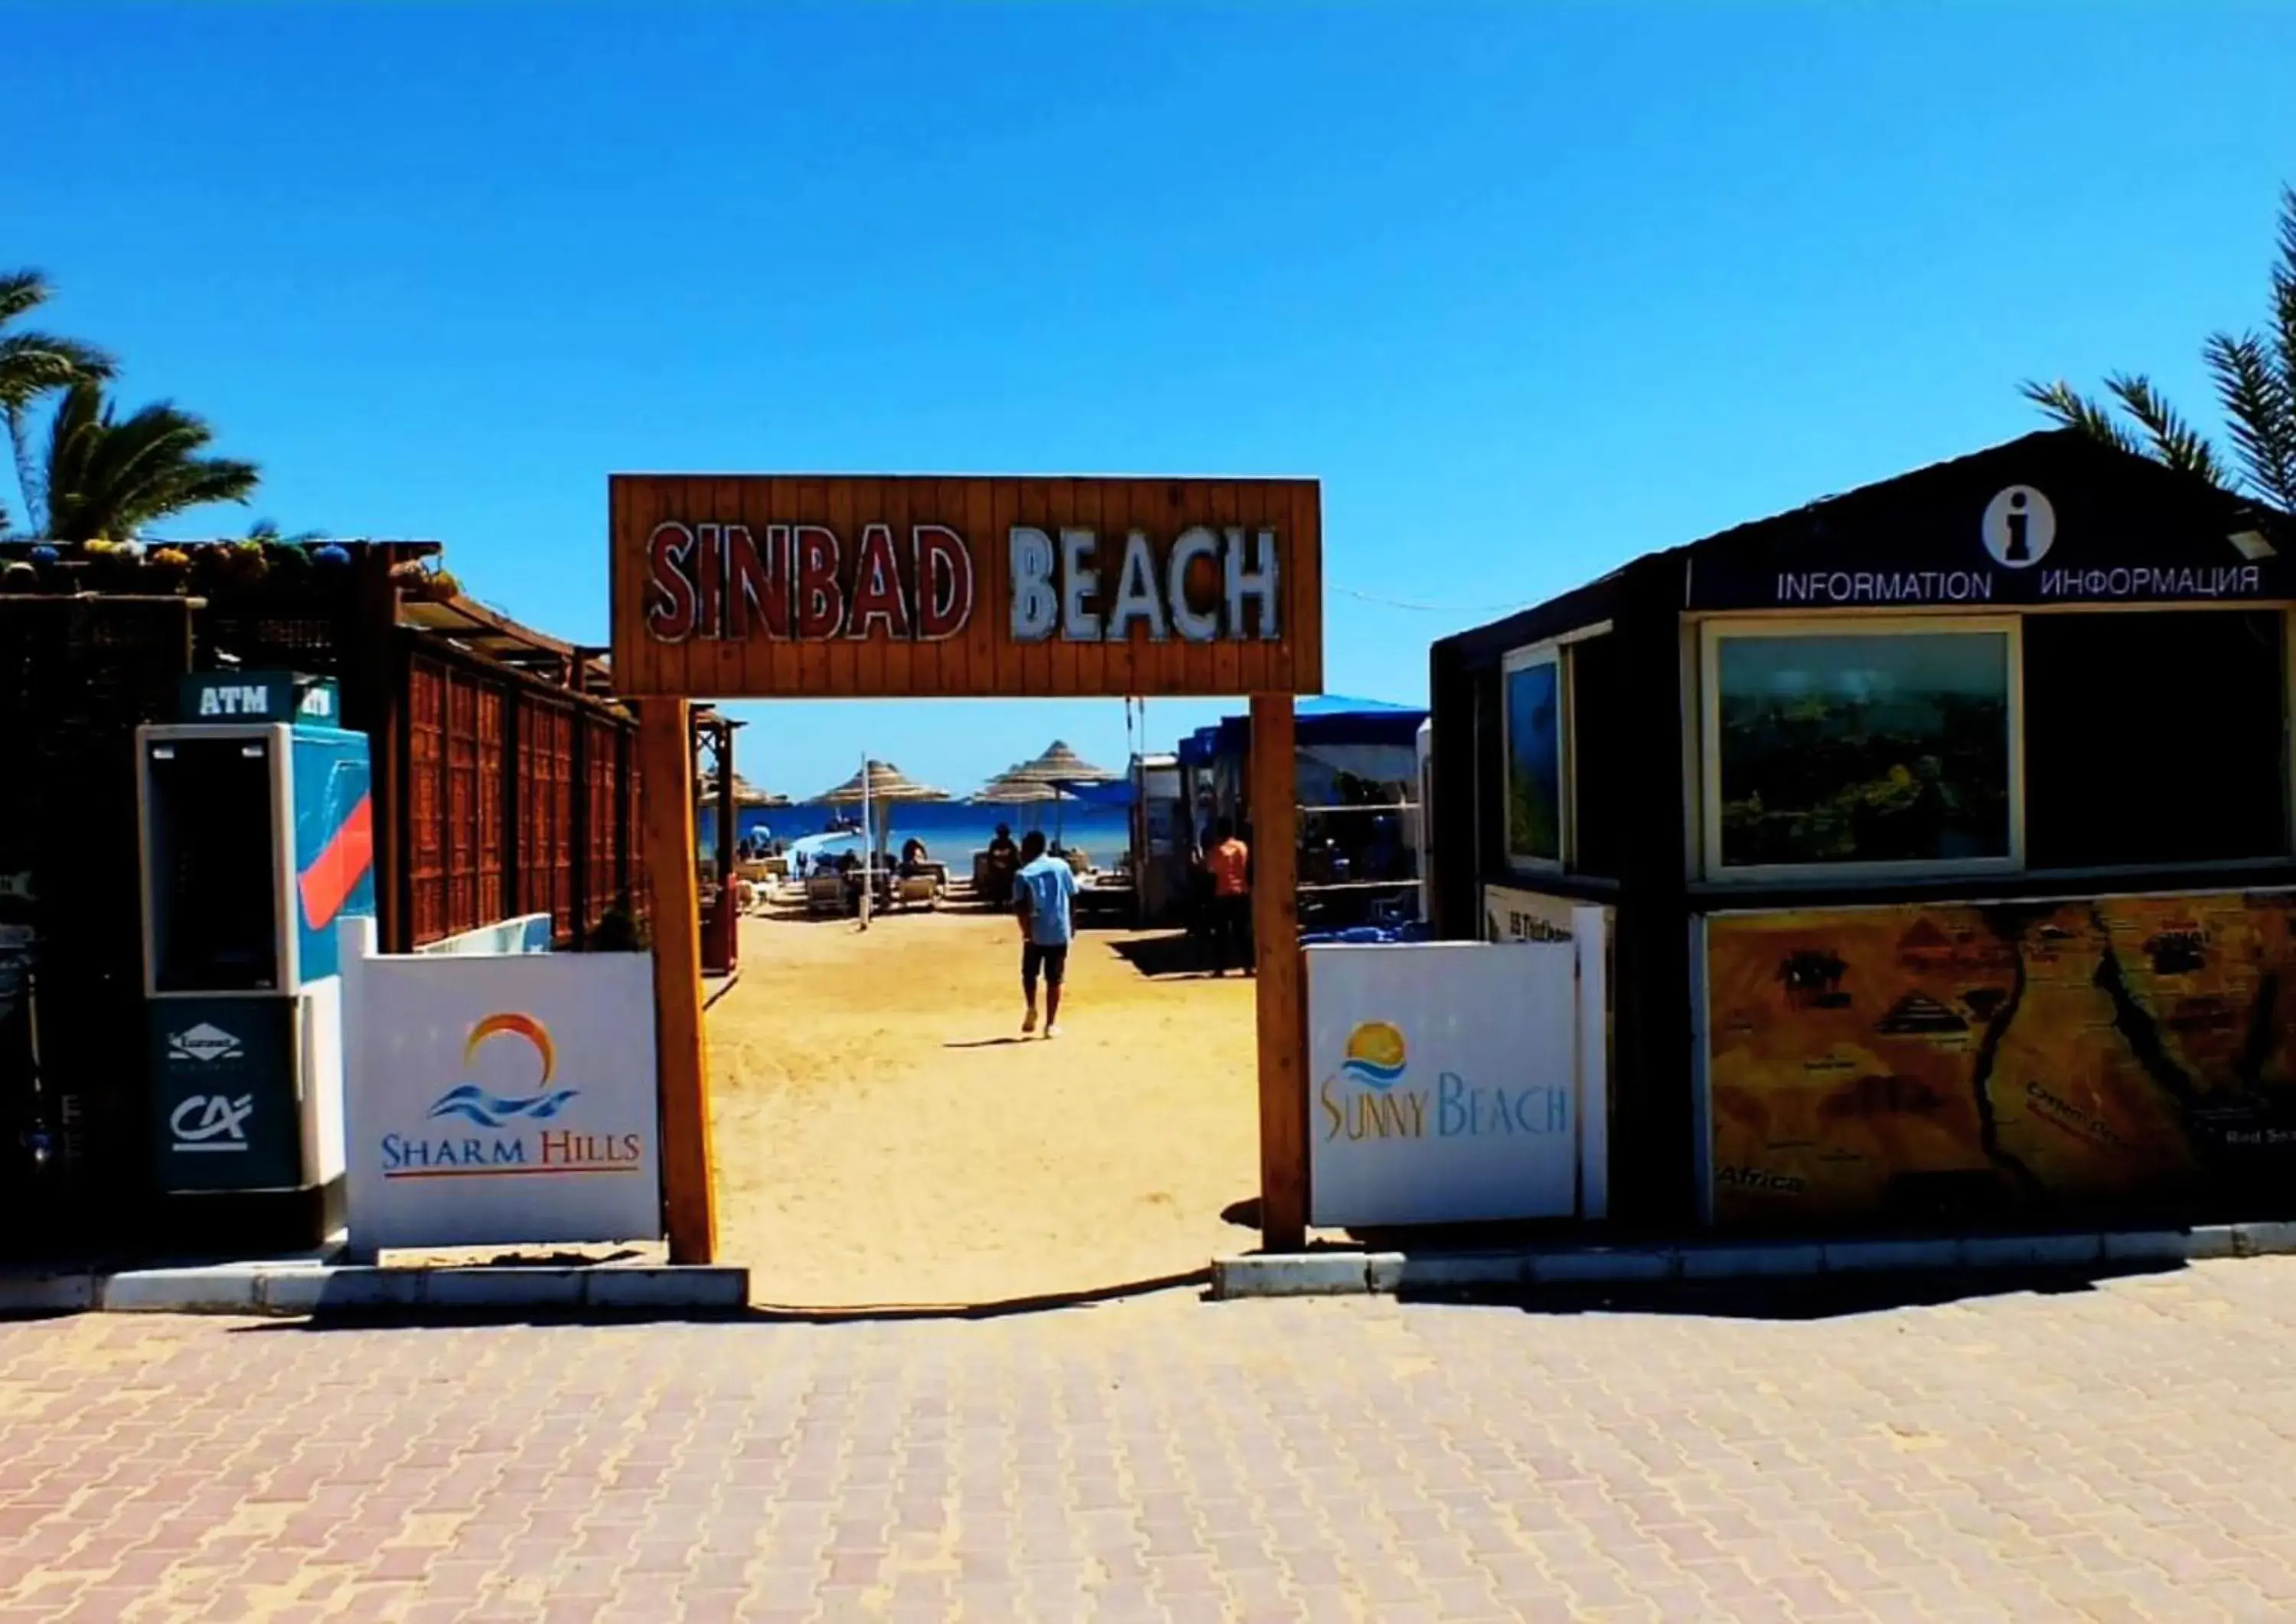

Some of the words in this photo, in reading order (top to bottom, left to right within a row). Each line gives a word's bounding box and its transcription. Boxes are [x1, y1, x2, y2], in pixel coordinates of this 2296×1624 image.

[646, 520, 975, 644] SINBAD
[1009, 525, 1281, 642] BEACH
[1777, 571, 1991, 601] INFORMATION
[2041, 566, 2260, 597] ИНФОРМАЦИЯ
[199, 686, 268, 716] ATM
[1320, 1075, 1429, 1142] SUNNY
[1439, 1071, 1566, 1137] BEACH
[381, 1133, 523, 1171] SHARM
[542, 1130, 640, 1164] HILLS
[1717, 1165, 1806, 1195] Africa
